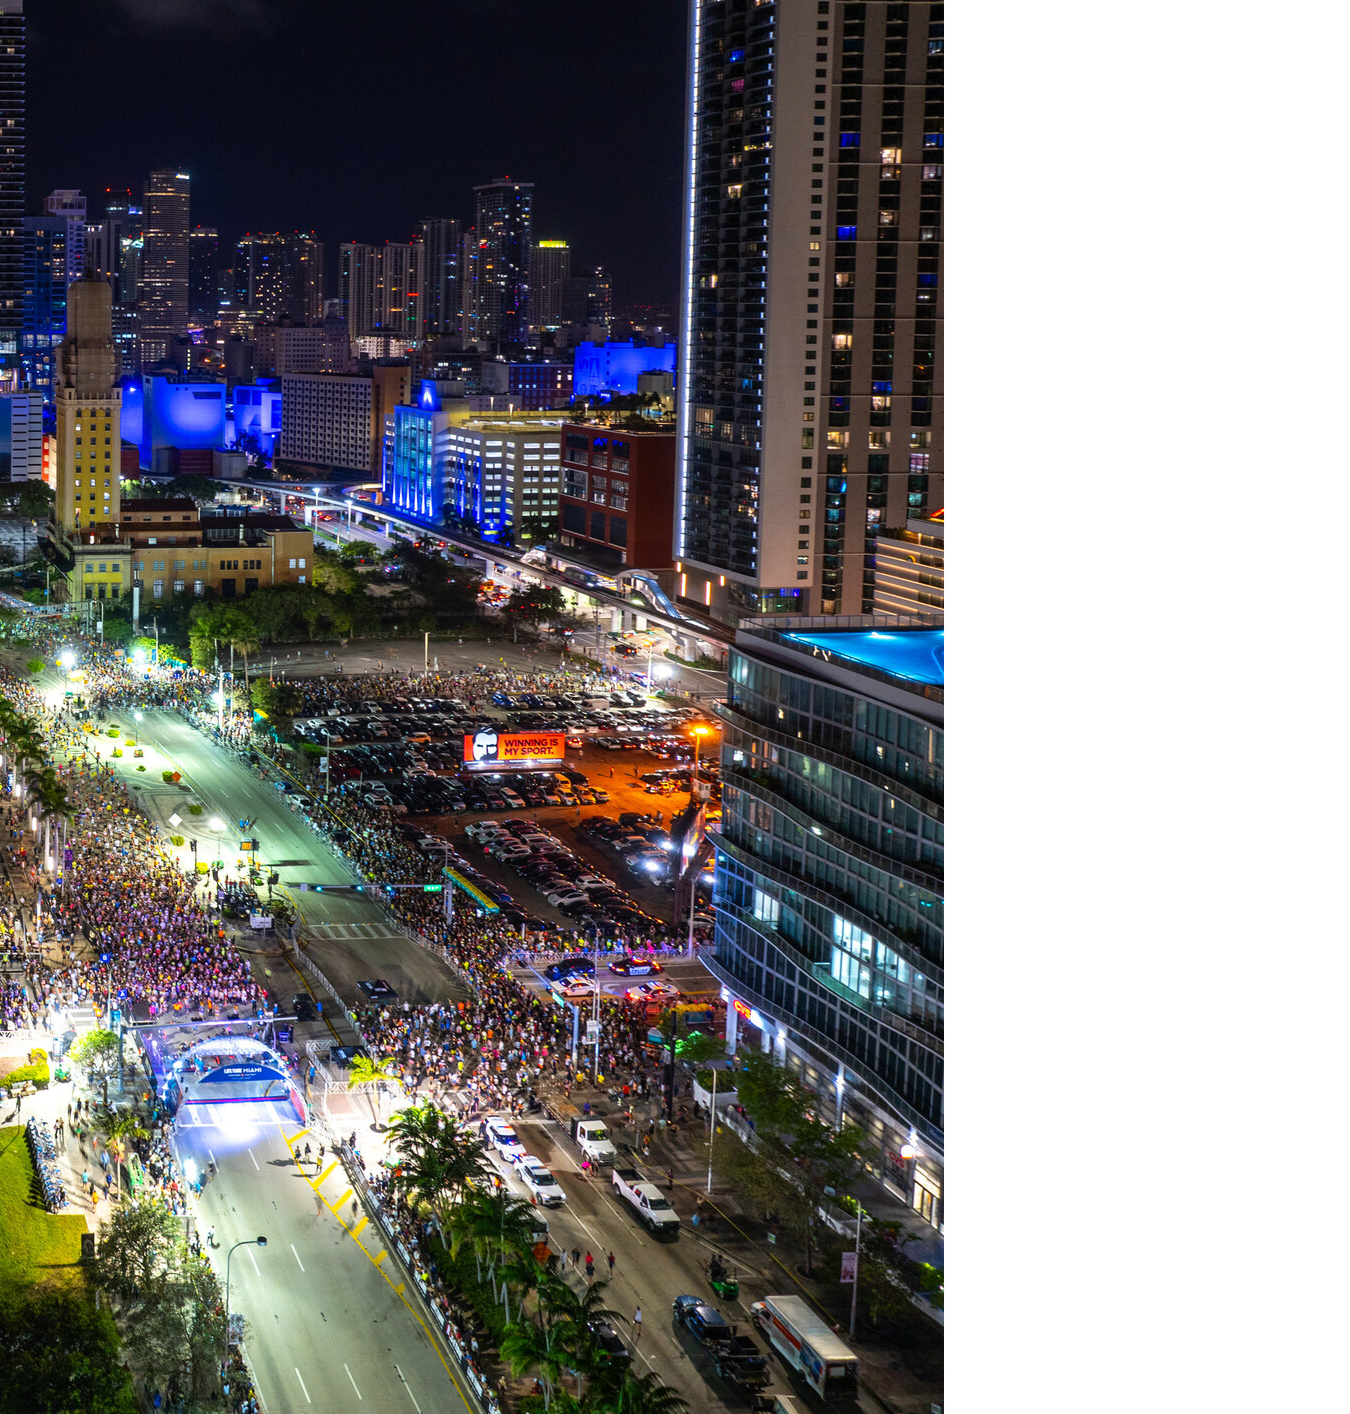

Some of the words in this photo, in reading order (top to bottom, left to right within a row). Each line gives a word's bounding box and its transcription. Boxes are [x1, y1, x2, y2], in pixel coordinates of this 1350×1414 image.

[504, 739, 547, 747] WINNING
[550, 738, 558, 747] IS
[521, 747, 554, 755] SPORT.
[733, 999, 751, 1019] CVS
[888, 1151, 904, 1168] CVS
